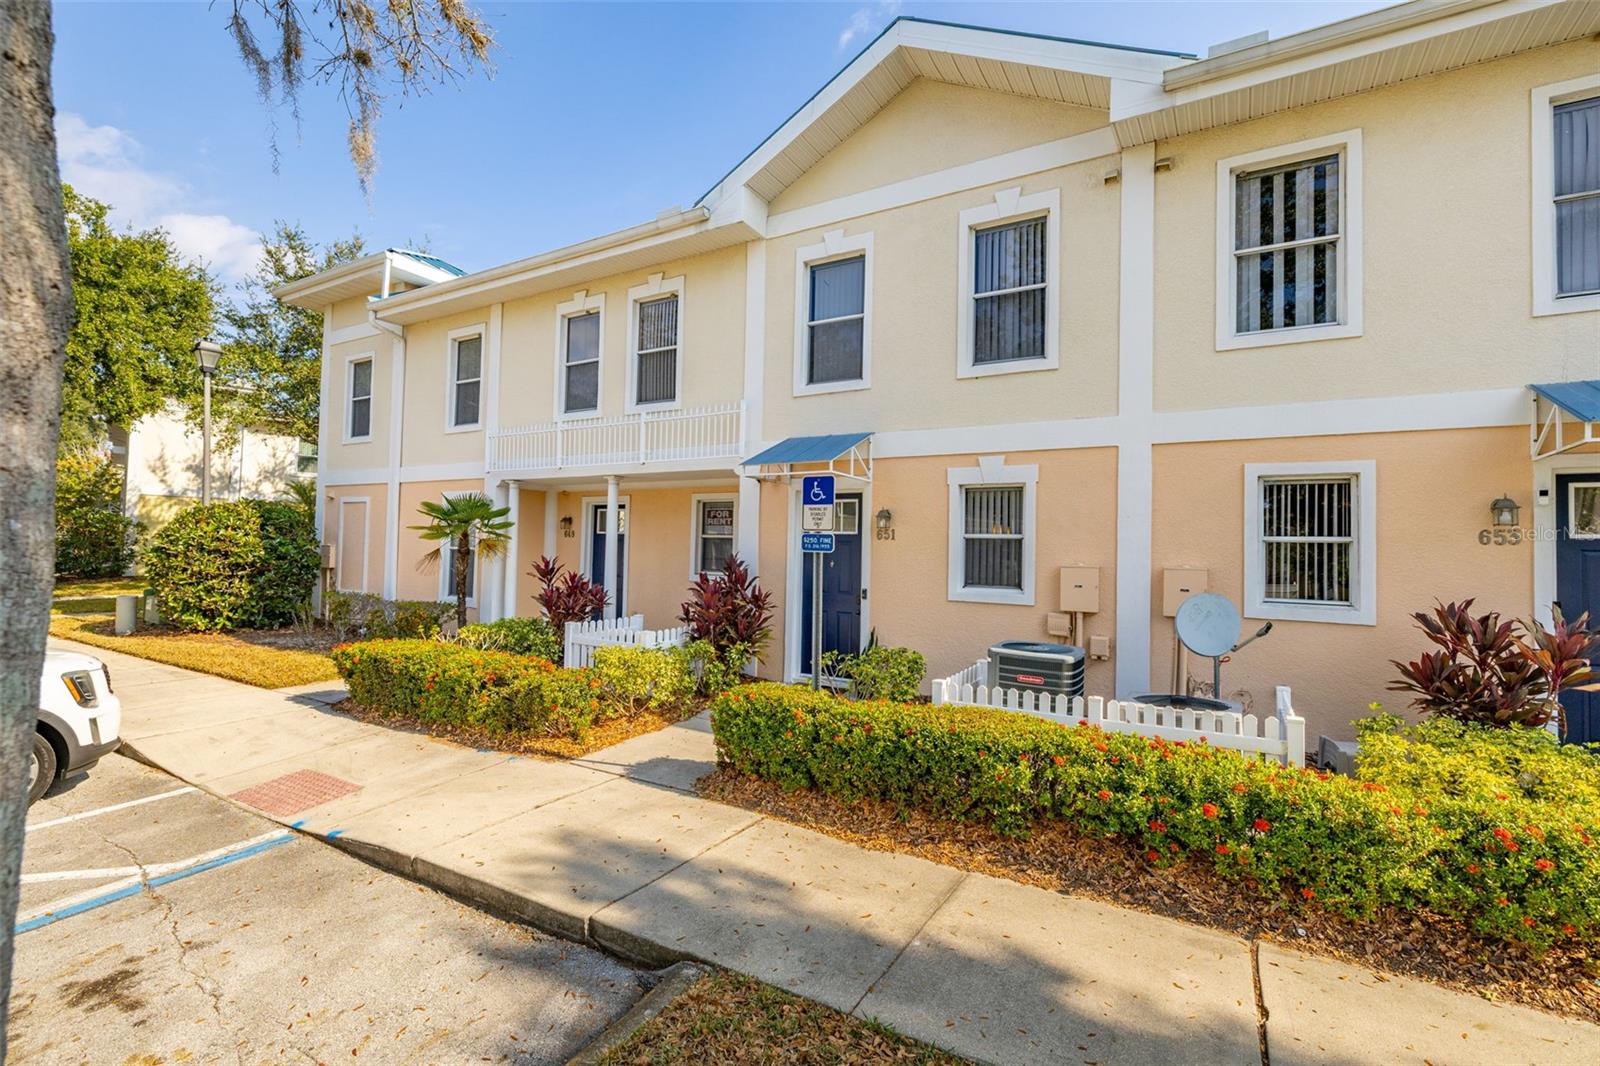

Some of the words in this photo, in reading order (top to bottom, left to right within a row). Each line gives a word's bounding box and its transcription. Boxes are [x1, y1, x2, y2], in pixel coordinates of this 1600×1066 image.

[711, 510, 729, 518] FOR
[876, 529, 896, 540] 651
[1478, 529, 1522, 545] 653
